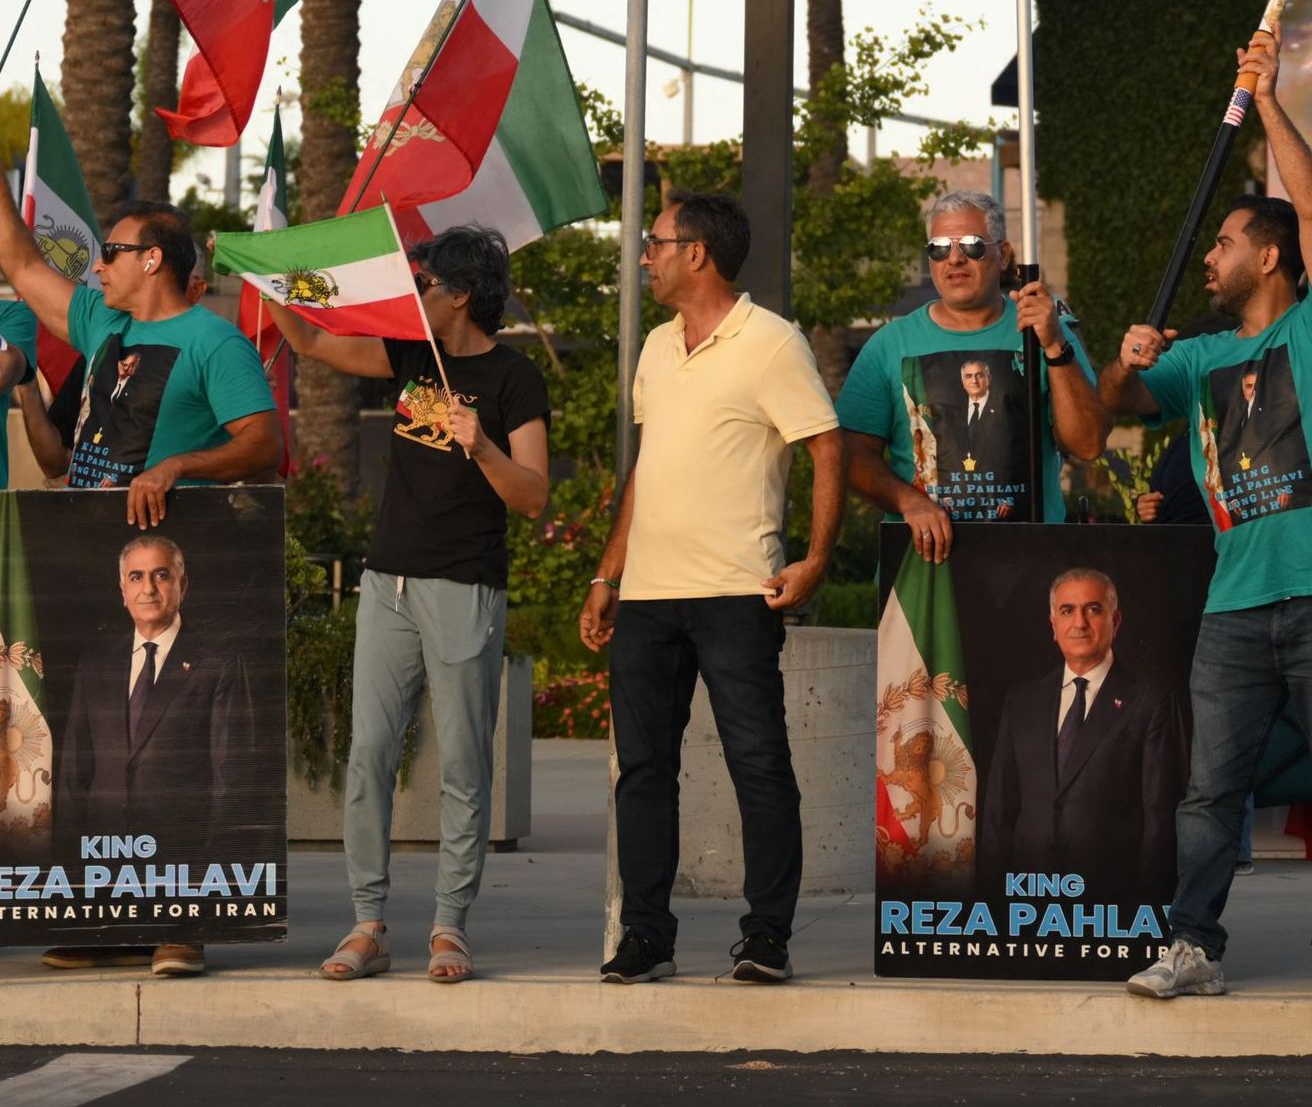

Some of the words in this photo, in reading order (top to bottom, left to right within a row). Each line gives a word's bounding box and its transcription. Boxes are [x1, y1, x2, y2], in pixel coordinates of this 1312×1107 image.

[951, 472, 995, 482] KING
[1231, 465, 1270, 483] KING
[1246, 470, 1304, 491] PAHLAVI
[967, 483, 1026, 494] PAHLAVI
[81, 835, 157, 859] KING
[84, 863, 277, 898] PAHLAVI
[1005, 873, 1085, 898] KING
[153, 904, 200, 918] FOR
[216, 903, 276, 916] IRAN
[881, 901, 998, 935] REZA
[1008, 903, 1171, 938] PAHLA
[882, 941, 1064, 957] ALTERNATIVE
[1081, 945, 1129, 958] FOR
[1146, 946, 1170, 958] IR
